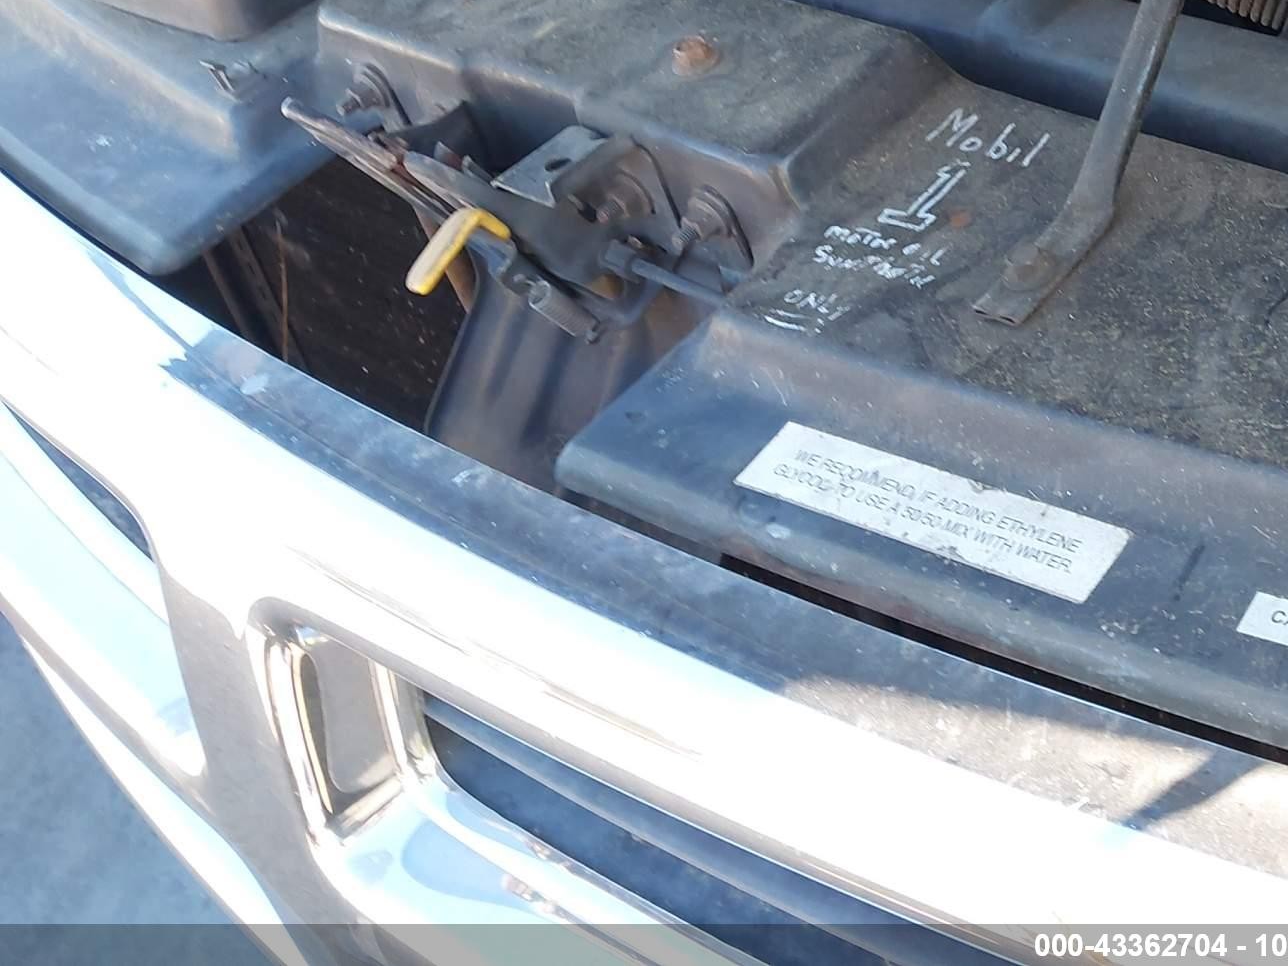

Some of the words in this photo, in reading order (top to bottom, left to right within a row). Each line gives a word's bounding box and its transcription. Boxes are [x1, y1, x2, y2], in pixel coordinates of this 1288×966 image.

[925, 107, 1051, 167] Mobil
[794, 449, 822, 467] WE
[919, 490, 938, 504] IF
[938, 496, 997, 525] ADDING
[998, 515, 1083, 553] ETHYLENE
[839, 482, 856, 498] TO
[855, 490, 890, 511] USE
[887, 501, 900, 515] A
[944, 519, 972, 539] MIX
[973, 529, 1013, 553] WITH
